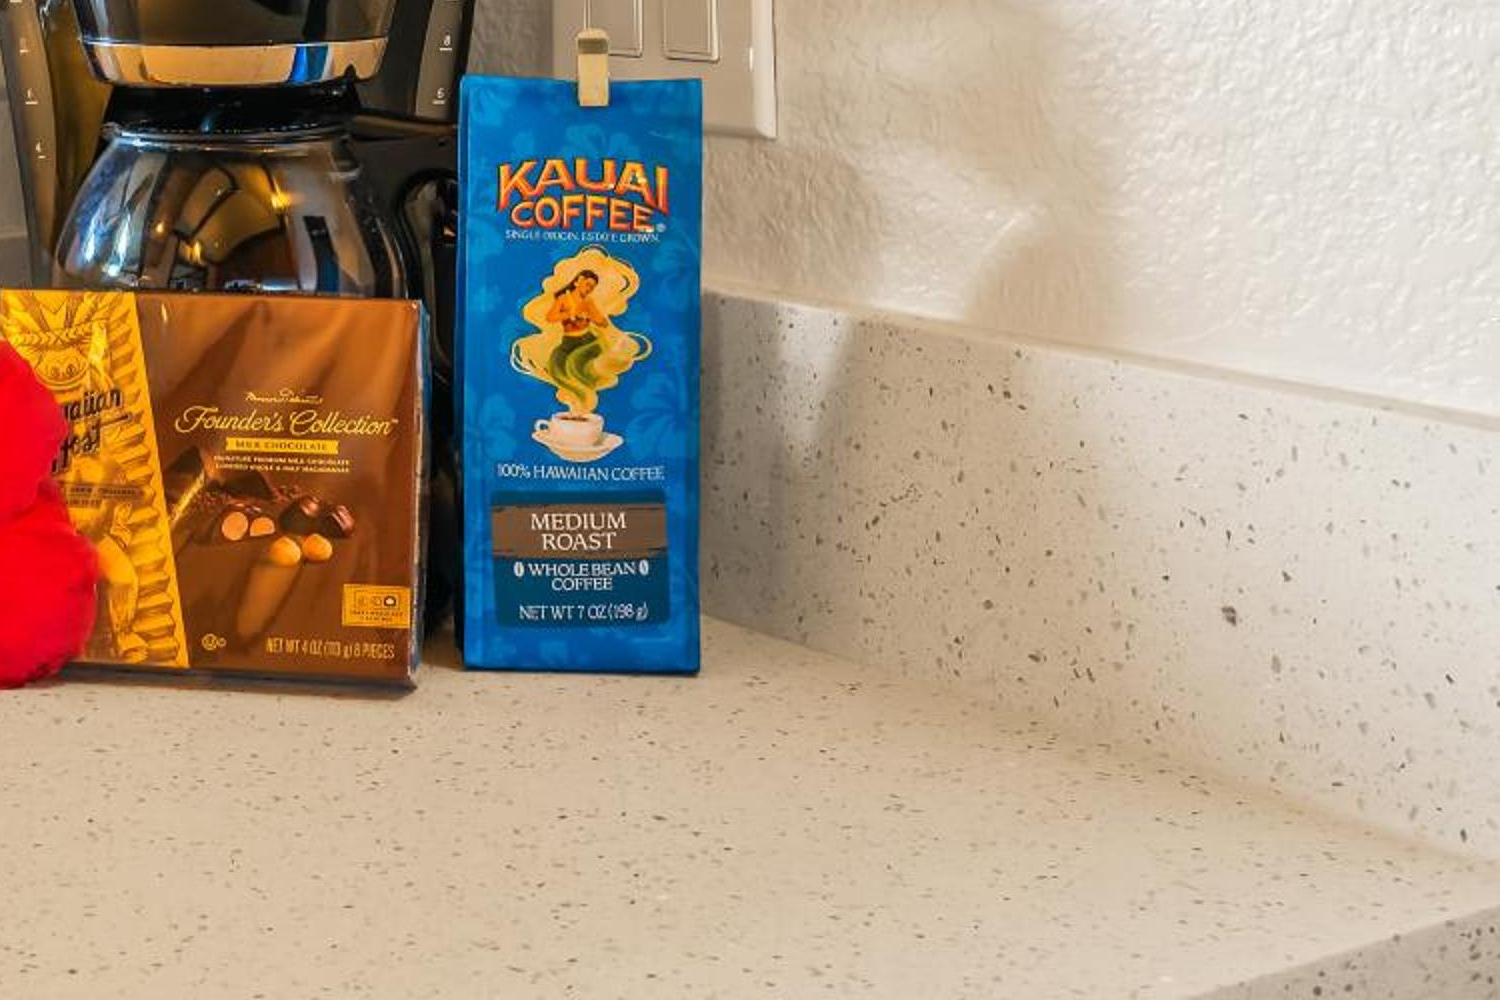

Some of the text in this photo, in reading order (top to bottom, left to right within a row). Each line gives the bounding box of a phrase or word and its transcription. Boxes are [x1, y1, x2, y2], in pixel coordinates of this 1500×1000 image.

[497, 158, 669, 215] KAUAI
[510, 194, 654, 232] COFFEE
[174, 405, 392, 436] Founder's Collection
[264, 440, 326, 450] CHOCOLATE
[497, 464, 665, 481] 100% HAWAIIAN COFFEE
[531, 512, 627, 532] MEDIUM
[542, 532, 617, 551] ROAST
[529, 561, 637, 577] WHOLE BEAN
[551, 577, 613, 591] COFFEE
[519, 605, 548, 620] NET
[550, 605, 575, 620] WT
[578, 605, 585, 619] 7
[587, 605, 607, 620] OZ
[267, 637, 284, 653] NET
